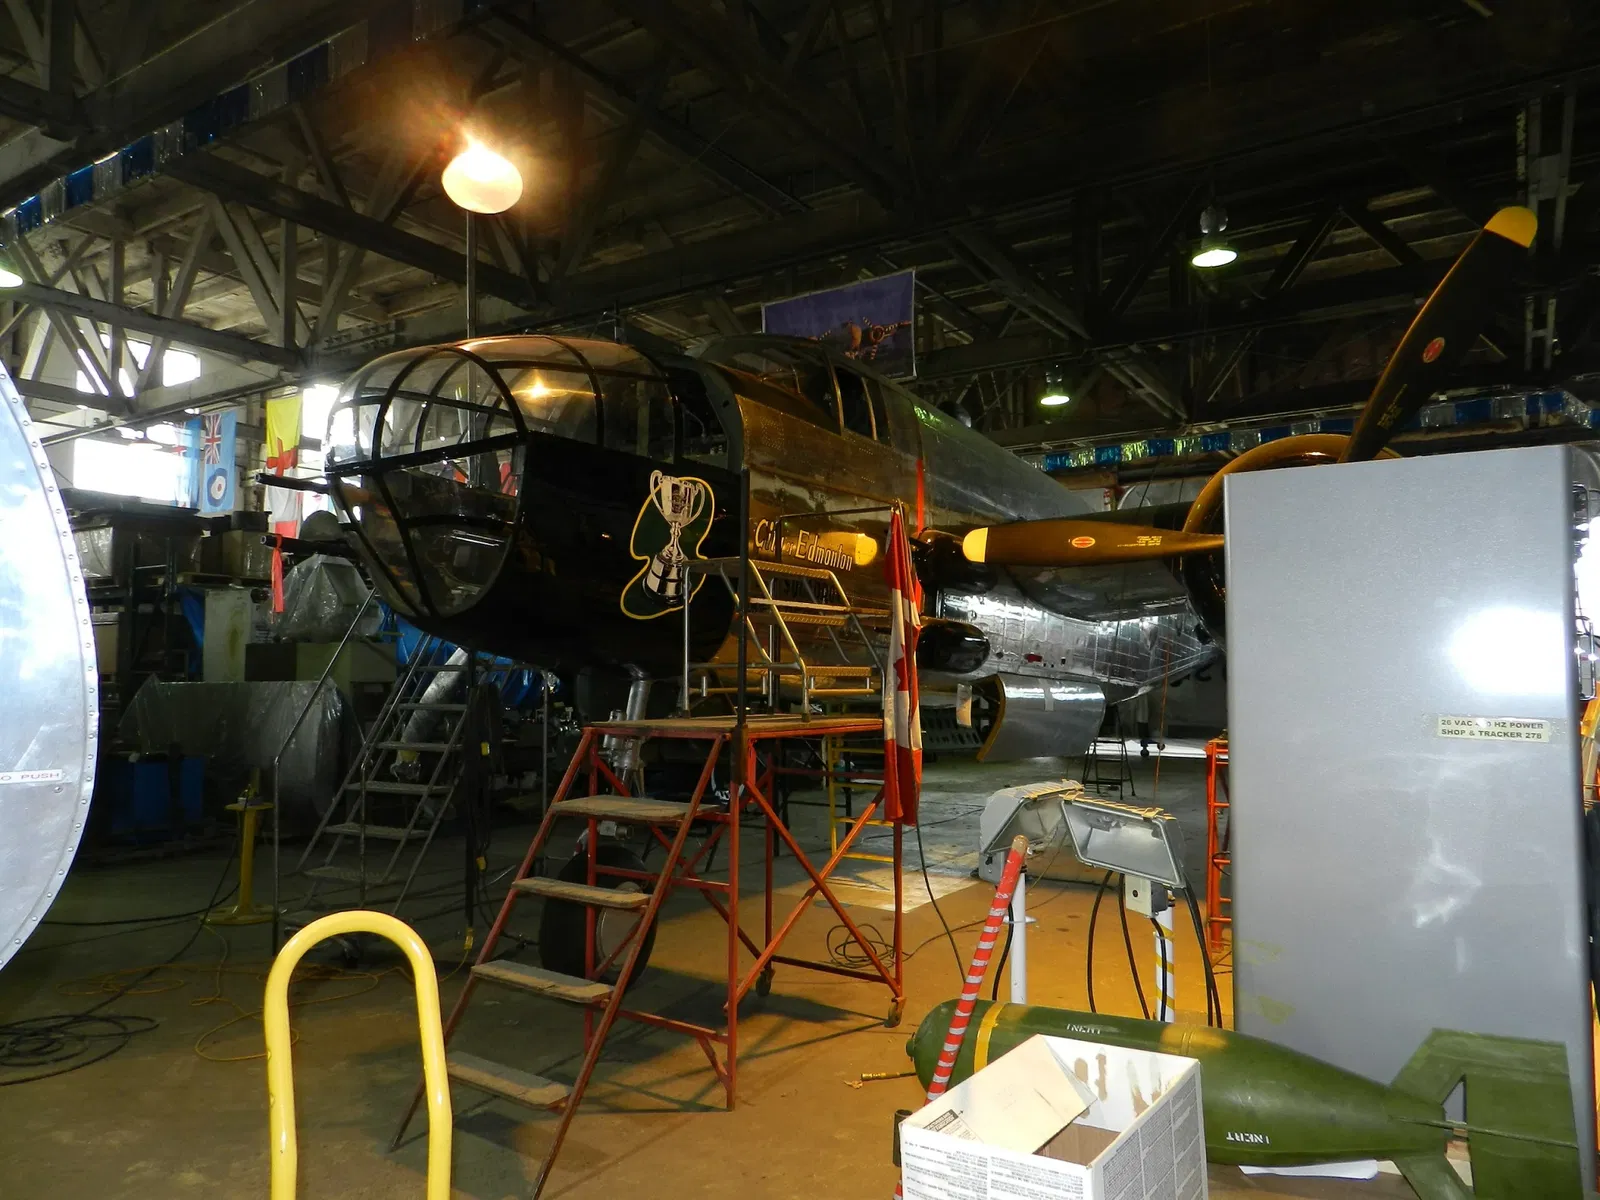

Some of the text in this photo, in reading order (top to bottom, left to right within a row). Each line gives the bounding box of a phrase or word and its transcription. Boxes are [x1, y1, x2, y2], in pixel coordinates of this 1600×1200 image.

[795, 529, 854, 571] Edmonton
[1494, 721, 1507, 729] HZ
[1510, 722, 1544, 730] POWER
[1478, 730, 1522, 738] TRACKER
[20, 772, 60, 780] PUSH
[1066, 1023, 1101, 1035] INERT
[1226, 1131, 1270, 1145] INERT
